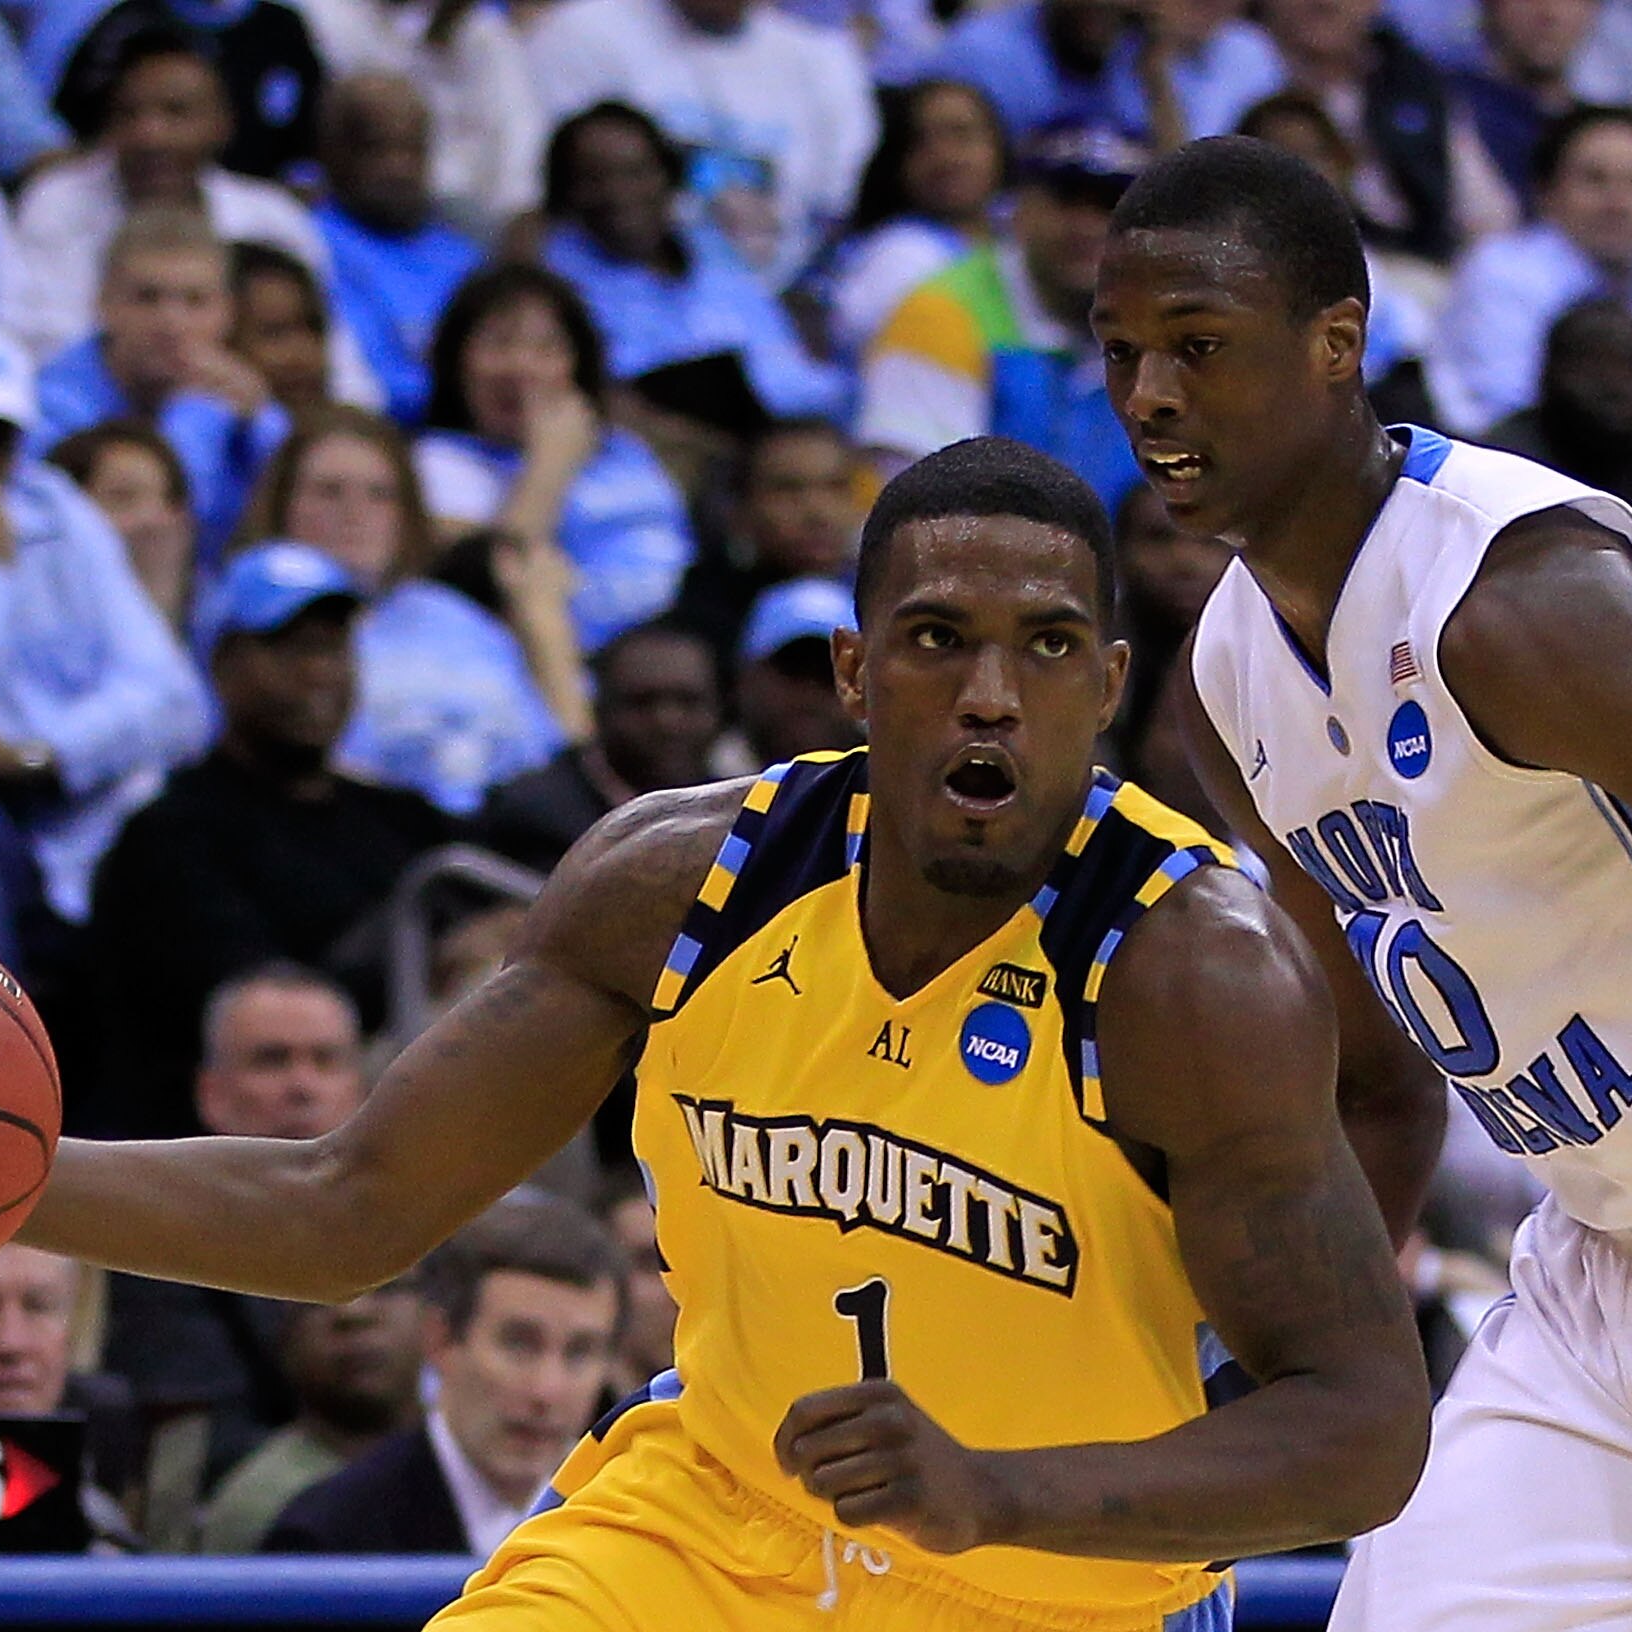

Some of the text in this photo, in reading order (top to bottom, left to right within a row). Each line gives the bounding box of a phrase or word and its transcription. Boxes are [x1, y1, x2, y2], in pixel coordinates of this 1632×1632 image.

[1394, 735, 1427, 760] NCAA
[867, 1020, 913, 1070] AL
[966, 1034, 1020, 1069] NCAA
[671, 1093, 1080, 1298] MARQUETTE
[834, 1276, 892, 1382] 1
